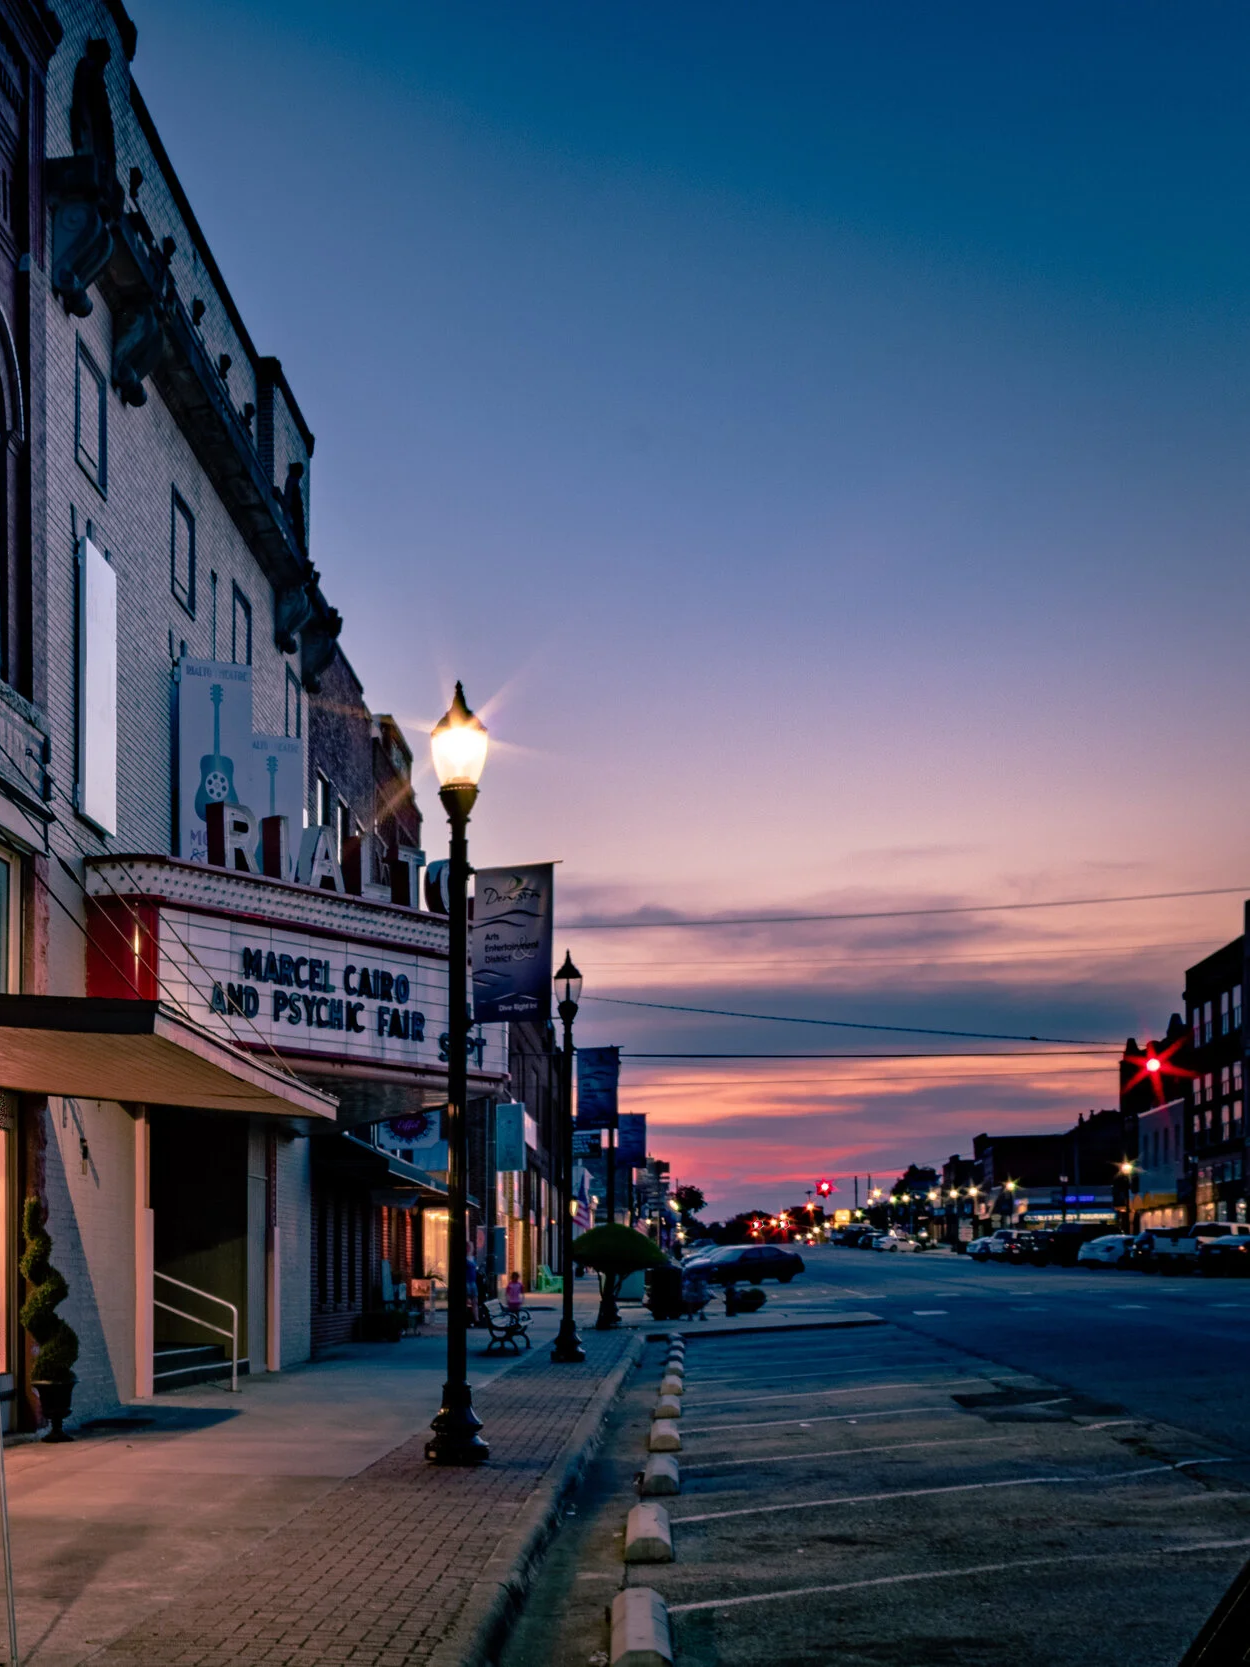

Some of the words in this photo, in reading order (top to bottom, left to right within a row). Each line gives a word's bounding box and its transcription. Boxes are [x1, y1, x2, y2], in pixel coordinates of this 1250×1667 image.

[484, 933, 499, 941] Arts
[484, 940, 539, 952] Entertainment
[242, 946, 336, 993] MARCEL
[343, 964, 411, 1004] CAIRO
[209, 981, 260, 1018] AND
[273, 989, 366, 1033] PSYCHIC
[377, 1005, 426, 1042] FAIR
